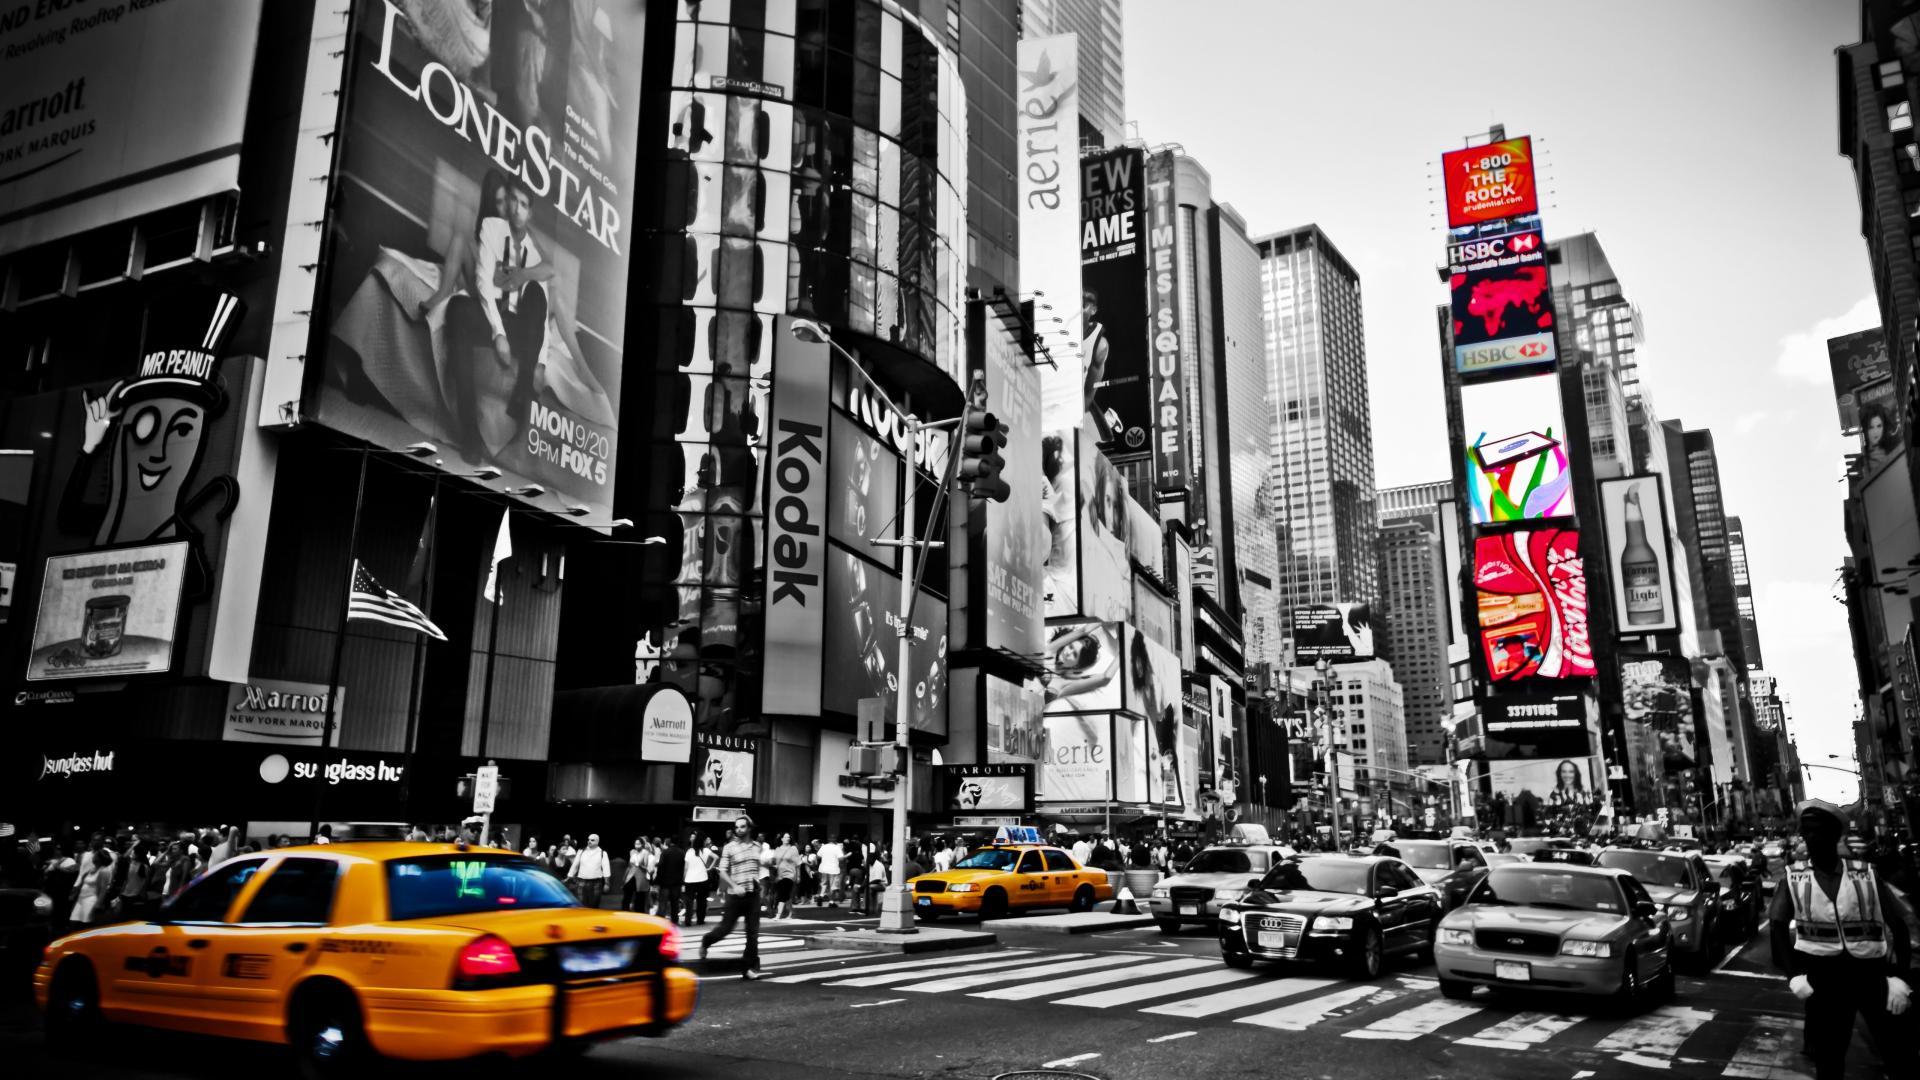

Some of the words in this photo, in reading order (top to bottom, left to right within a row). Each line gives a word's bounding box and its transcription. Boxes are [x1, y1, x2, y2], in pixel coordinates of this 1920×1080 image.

[5, 27, 67, 60] Revolving
[70, 5, 125, 35] Rooftop
[28, 119, 96, 154] MARQUIS
[1018, 96, 1061, 210] aerie
[1462, 153, 1511, 173] 1-800
[1470, 170, 1506, 187] THE
[1463, 197, 1523, 213] prudential.com
[1465, 182, 1516, 204] ROCK
[1147, 180, 1173, 294] TIMES
[1451, 239, 1505, 264] HSBC
[141, 351, 165, 377] MR.
[166, 350, 215, 380] PEANUT
[1463, 345, 1516, 365] HSBC
[1155, 307, 1179, 454] SQUARE
[530, 400, 574, 443] MON
[575, 424, 609, 460] 9/20
[560, 443, 593, 480] FOX
[594, 461, 607, 485] 5
[772, 419, 823, 608] Kodak
[235, 686, 336, 713] Marriot
[229, 714, 254, 724] NEW
[257, 716, 287, 726] YORK
[290, 719, 337, 730] MARQUS
[650, 717, 686, 731] Marriott
[698, 732, 755, 750] MARQUIS
[46, 752, 92, 778] sunglass
[93, 750, 114, 770] hut
